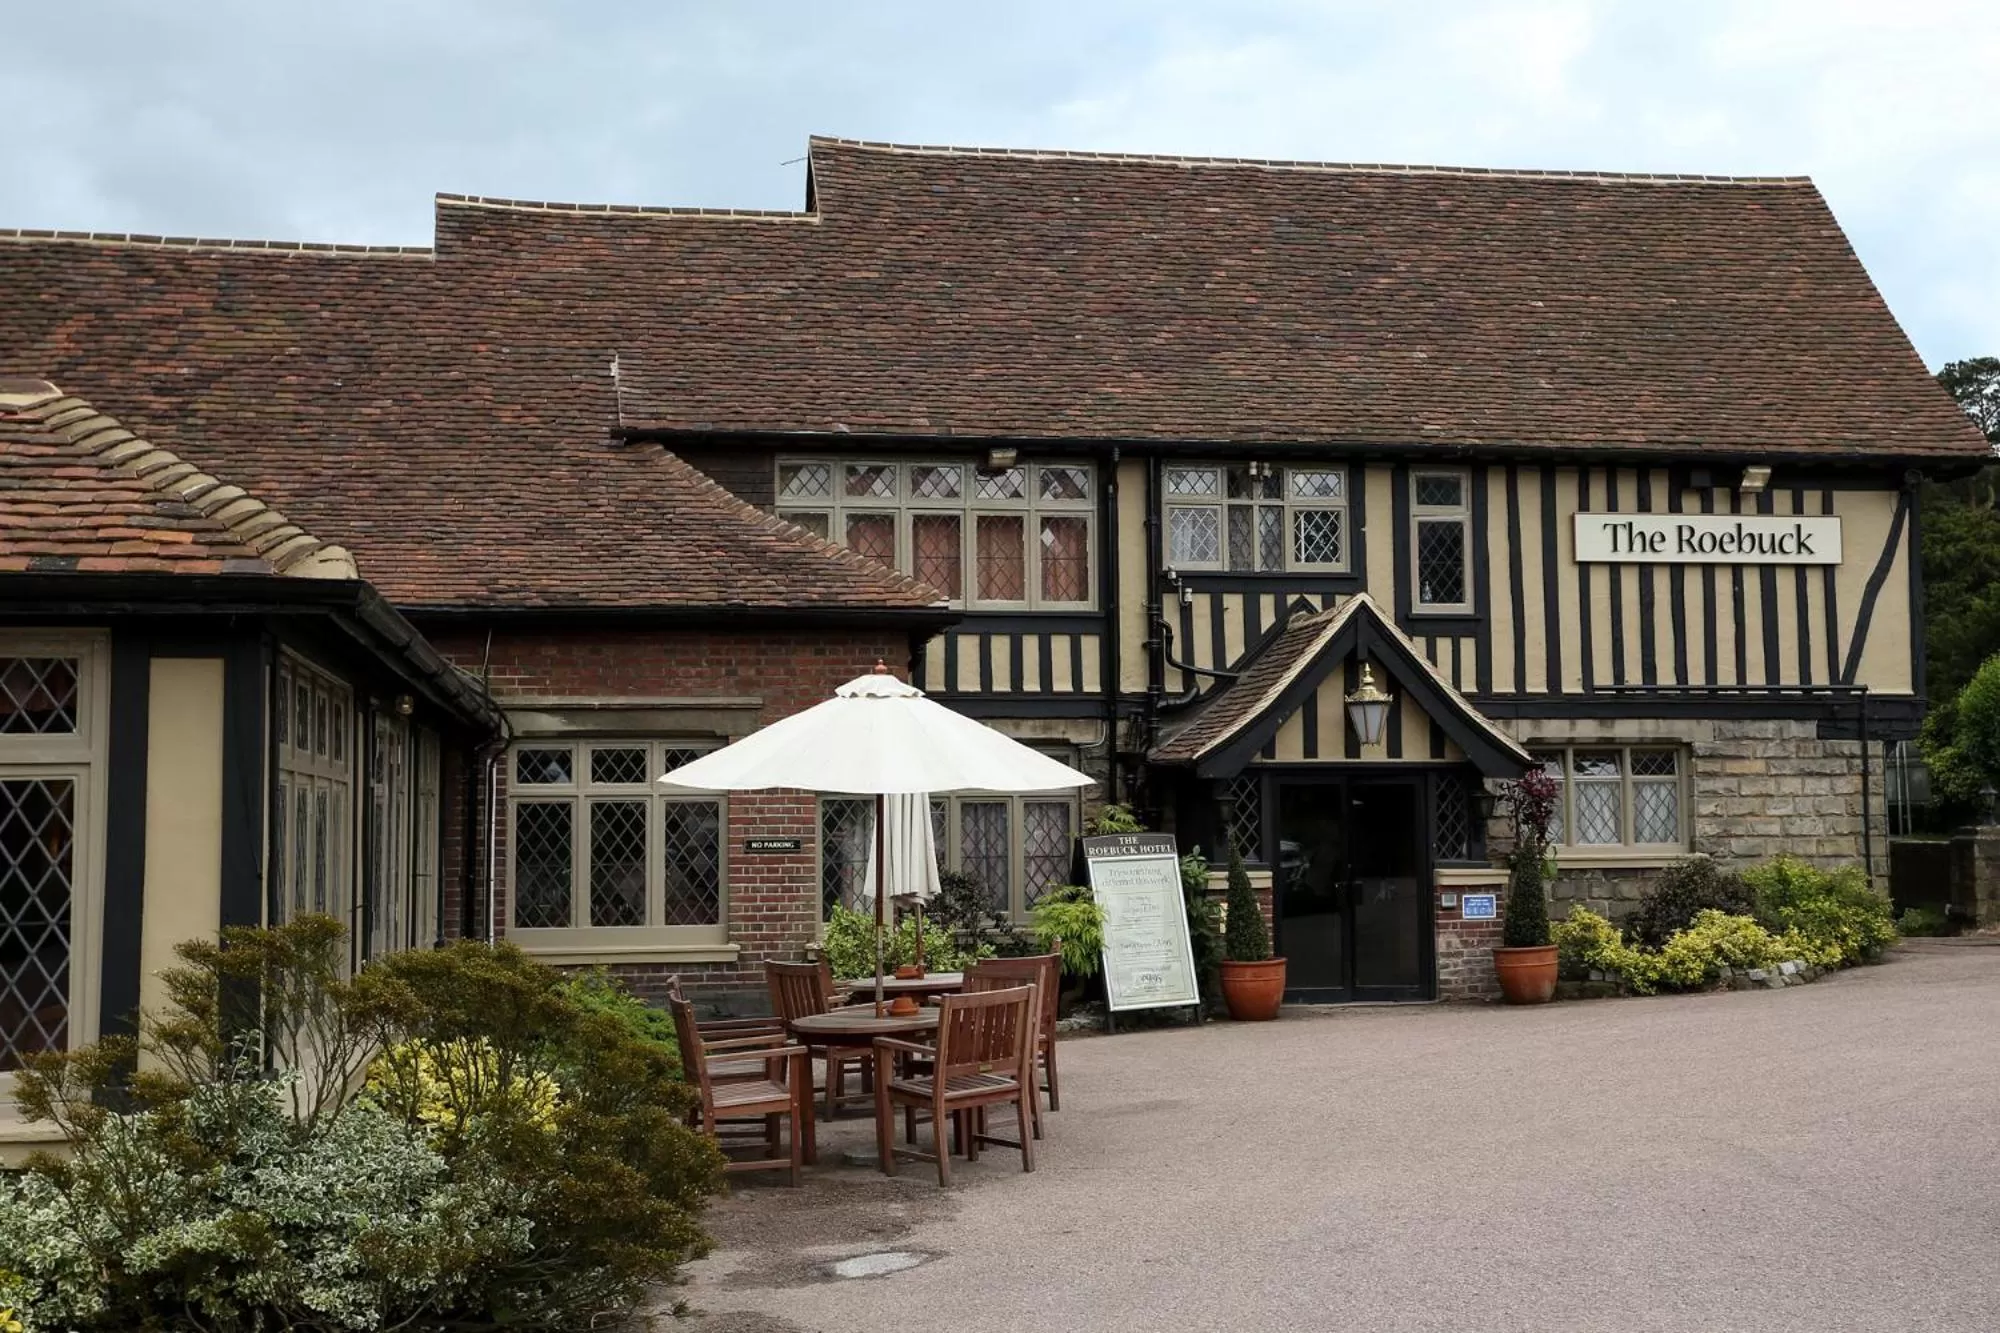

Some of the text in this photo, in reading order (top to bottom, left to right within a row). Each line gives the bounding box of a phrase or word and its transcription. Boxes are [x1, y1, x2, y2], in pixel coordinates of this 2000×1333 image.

[1603, 521, 1815, 555] The Roebuck
[1118, 836, 1139, 845] THE
[1088, 844, 1174, 856] ROEBUCK HOTEL
